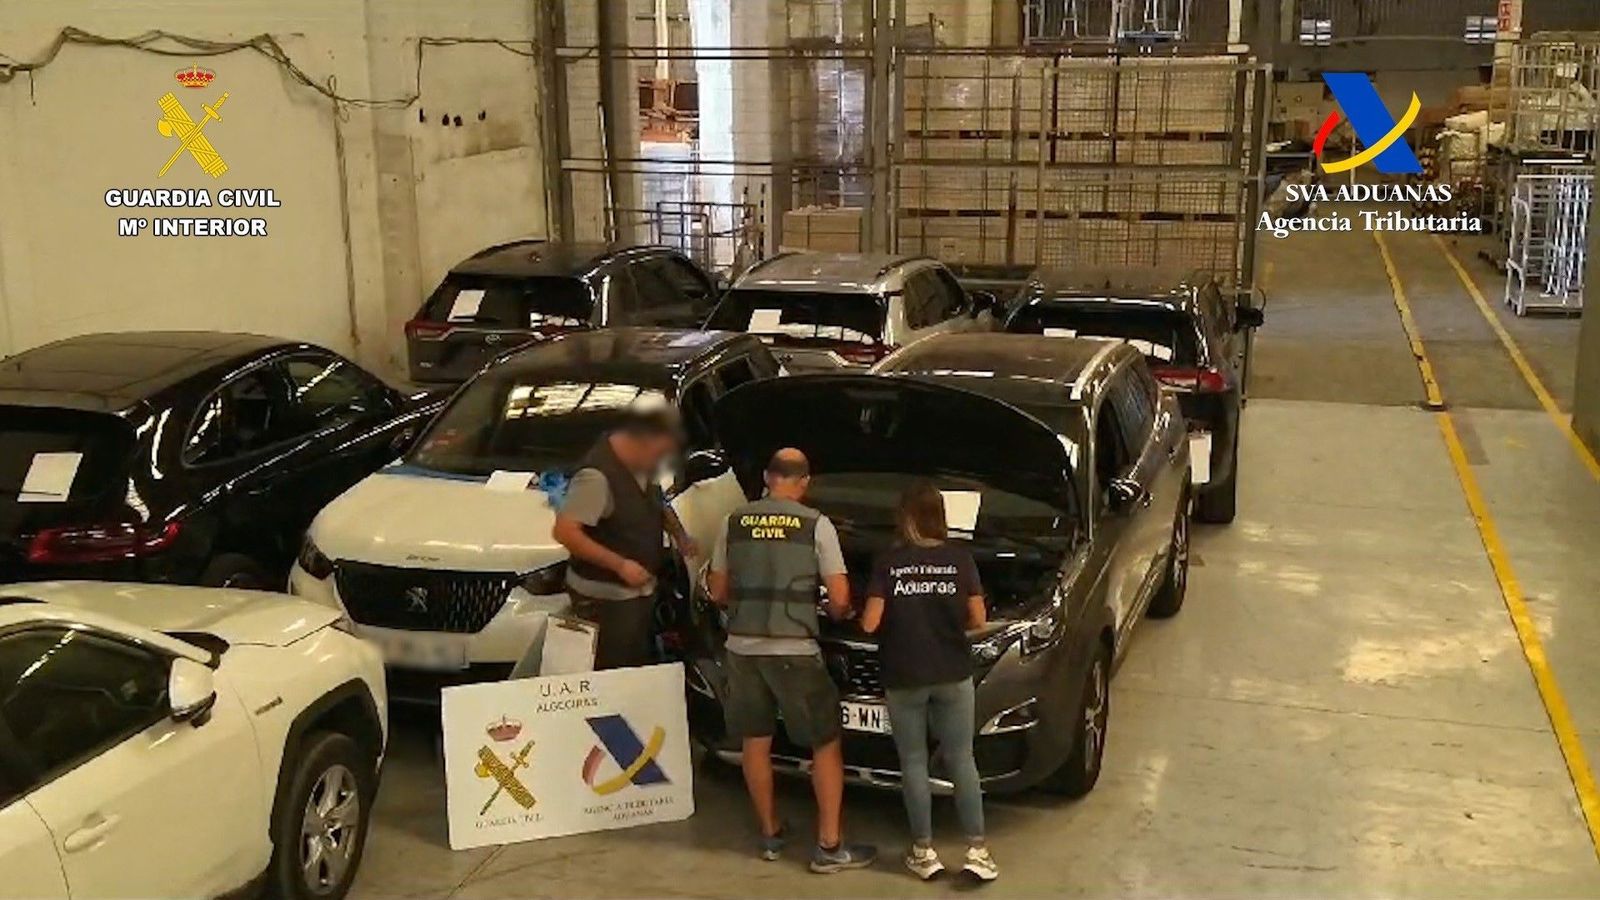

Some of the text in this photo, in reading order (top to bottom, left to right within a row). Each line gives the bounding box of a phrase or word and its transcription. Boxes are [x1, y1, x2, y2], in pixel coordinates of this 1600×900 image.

[740, 514, 801, 529] GUARDIA
[751, 527, 786, 539] CIVIL
[893, 579, 957, 597] Aduanas
